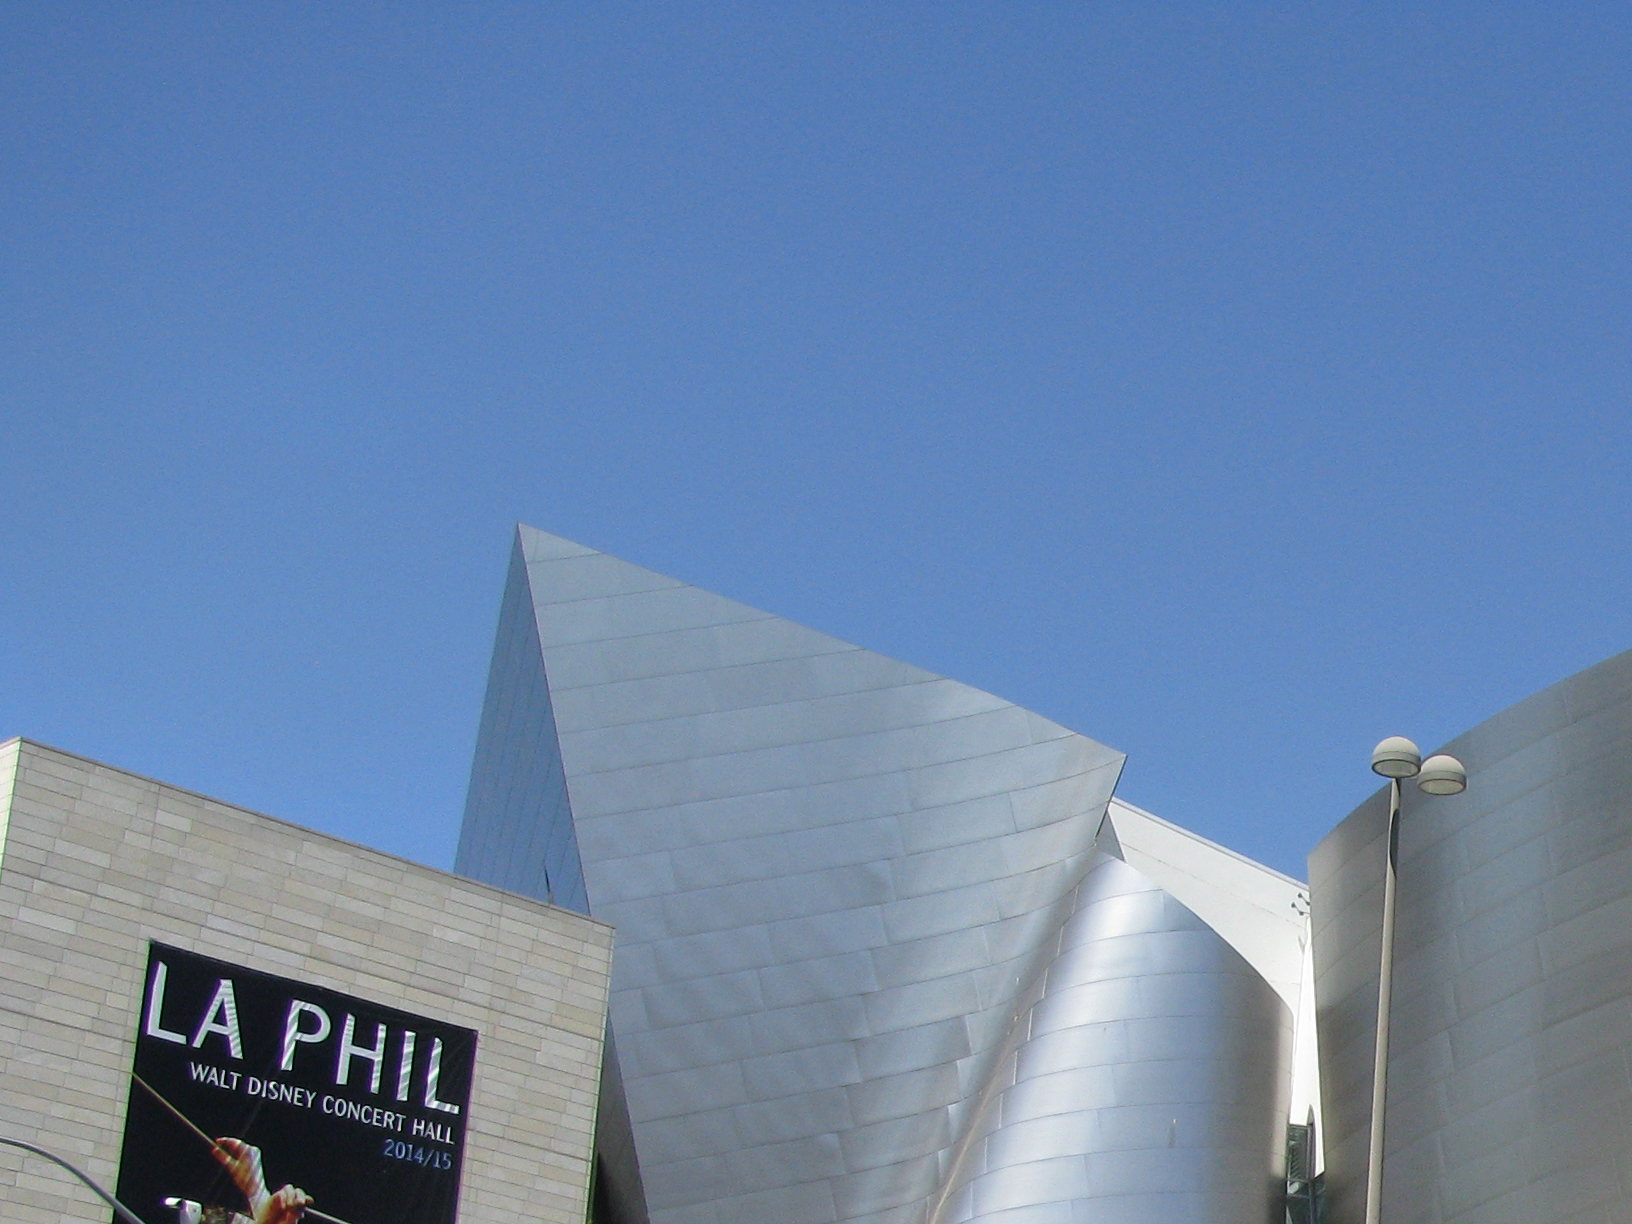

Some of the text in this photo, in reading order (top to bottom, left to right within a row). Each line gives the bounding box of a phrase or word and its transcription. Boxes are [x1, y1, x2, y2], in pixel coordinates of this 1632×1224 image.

[146, 961, 460, 1115] LA PHIL
[190, 1061, 455, 1145] WALT DISNEY CONCERT HALL
[383, 1138, 452, 1171] 2014/15
